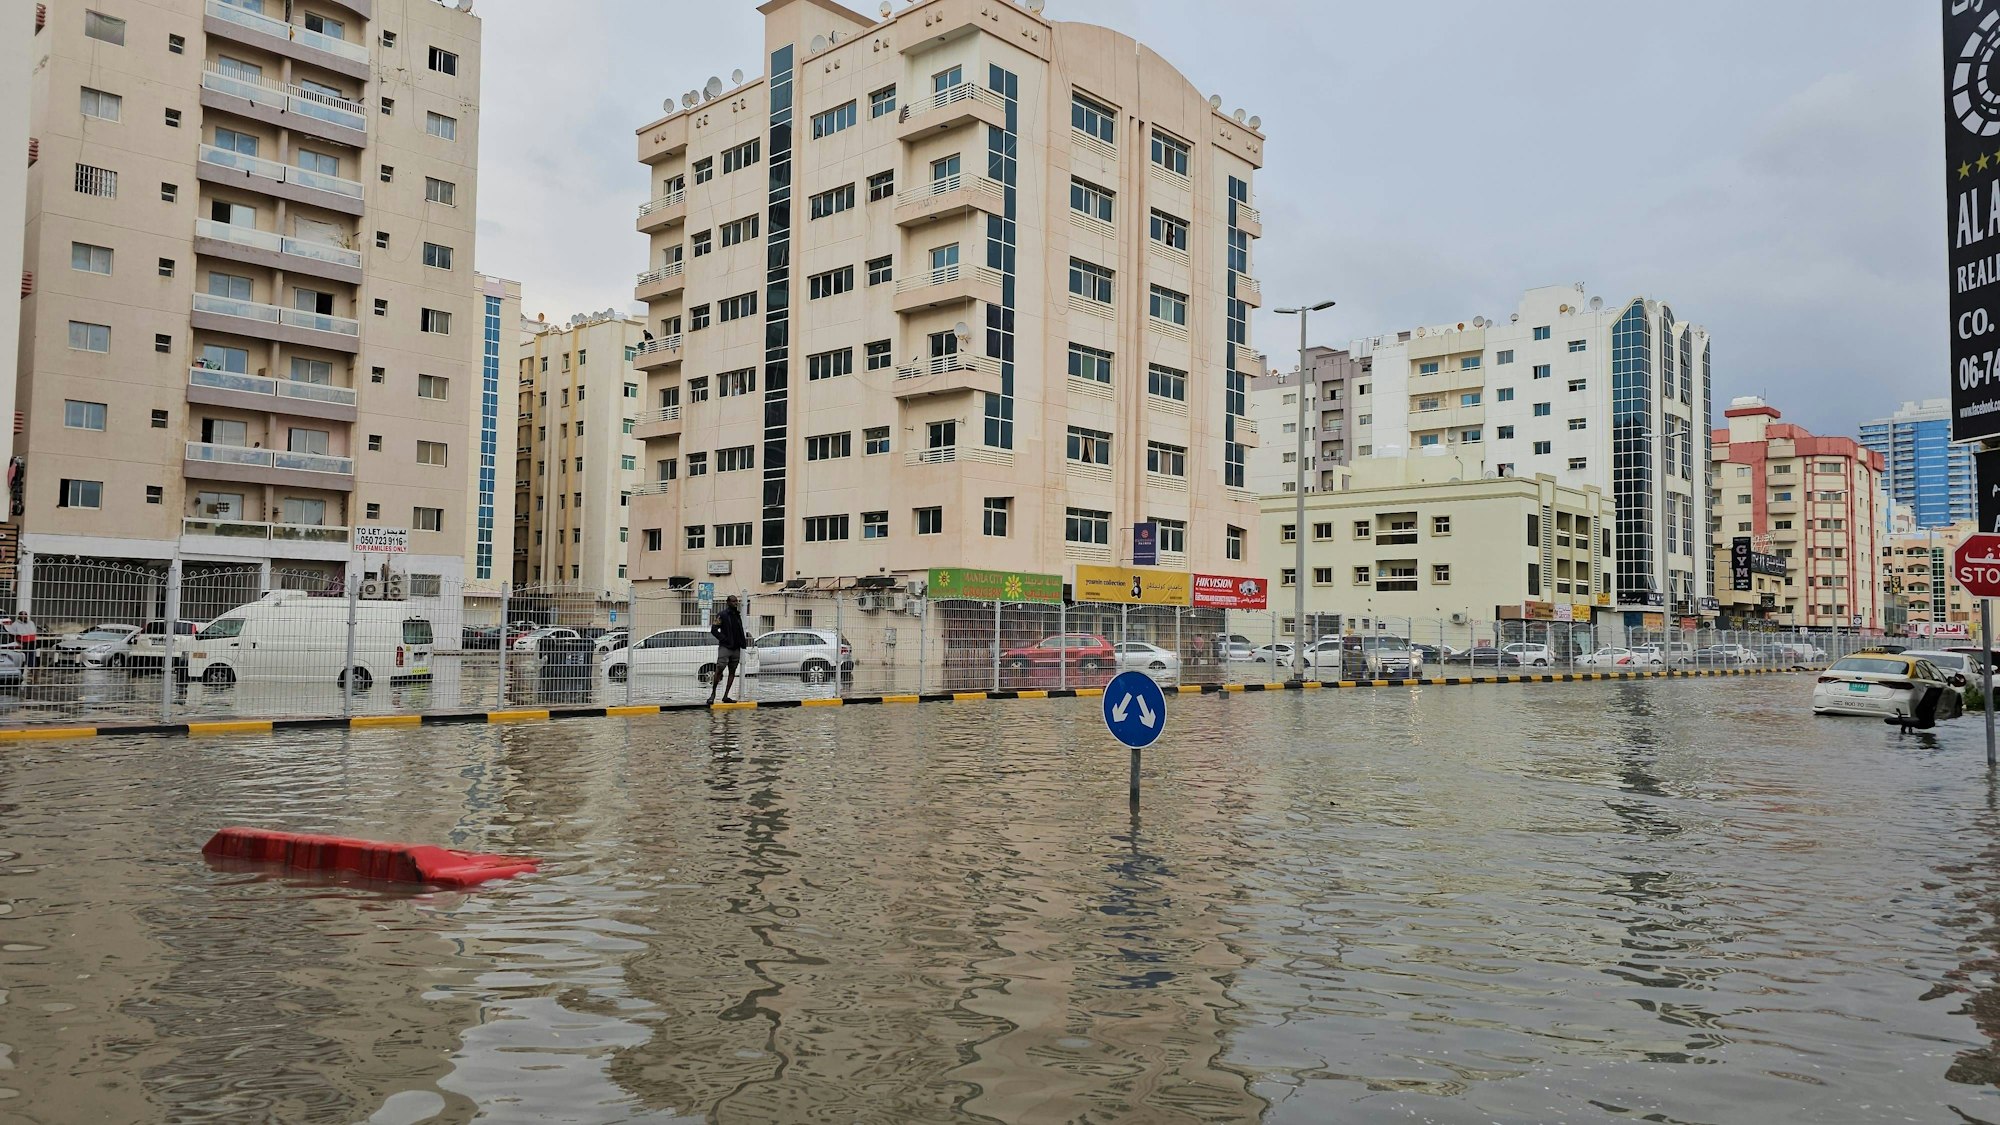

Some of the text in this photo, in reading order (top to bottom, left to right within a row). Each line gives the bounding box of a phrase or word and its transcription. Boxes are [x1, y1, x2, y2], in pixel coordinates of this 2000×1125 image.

[1956, 188, 1984, 249] AL
[1958, 308, 1995, 340] CO.
[356, 527, 381, 536] TO LET
[360, 535, 403, 546] 050 723 9116
[989, 573, 1004, 585] CITY
[1960, 566, 2000, 585] STO
[1103, 579, 1127, 587] collection
[1195, 577, 1234, 589] HIKVISION
[961, 586, 1003, 598] GROCERY
